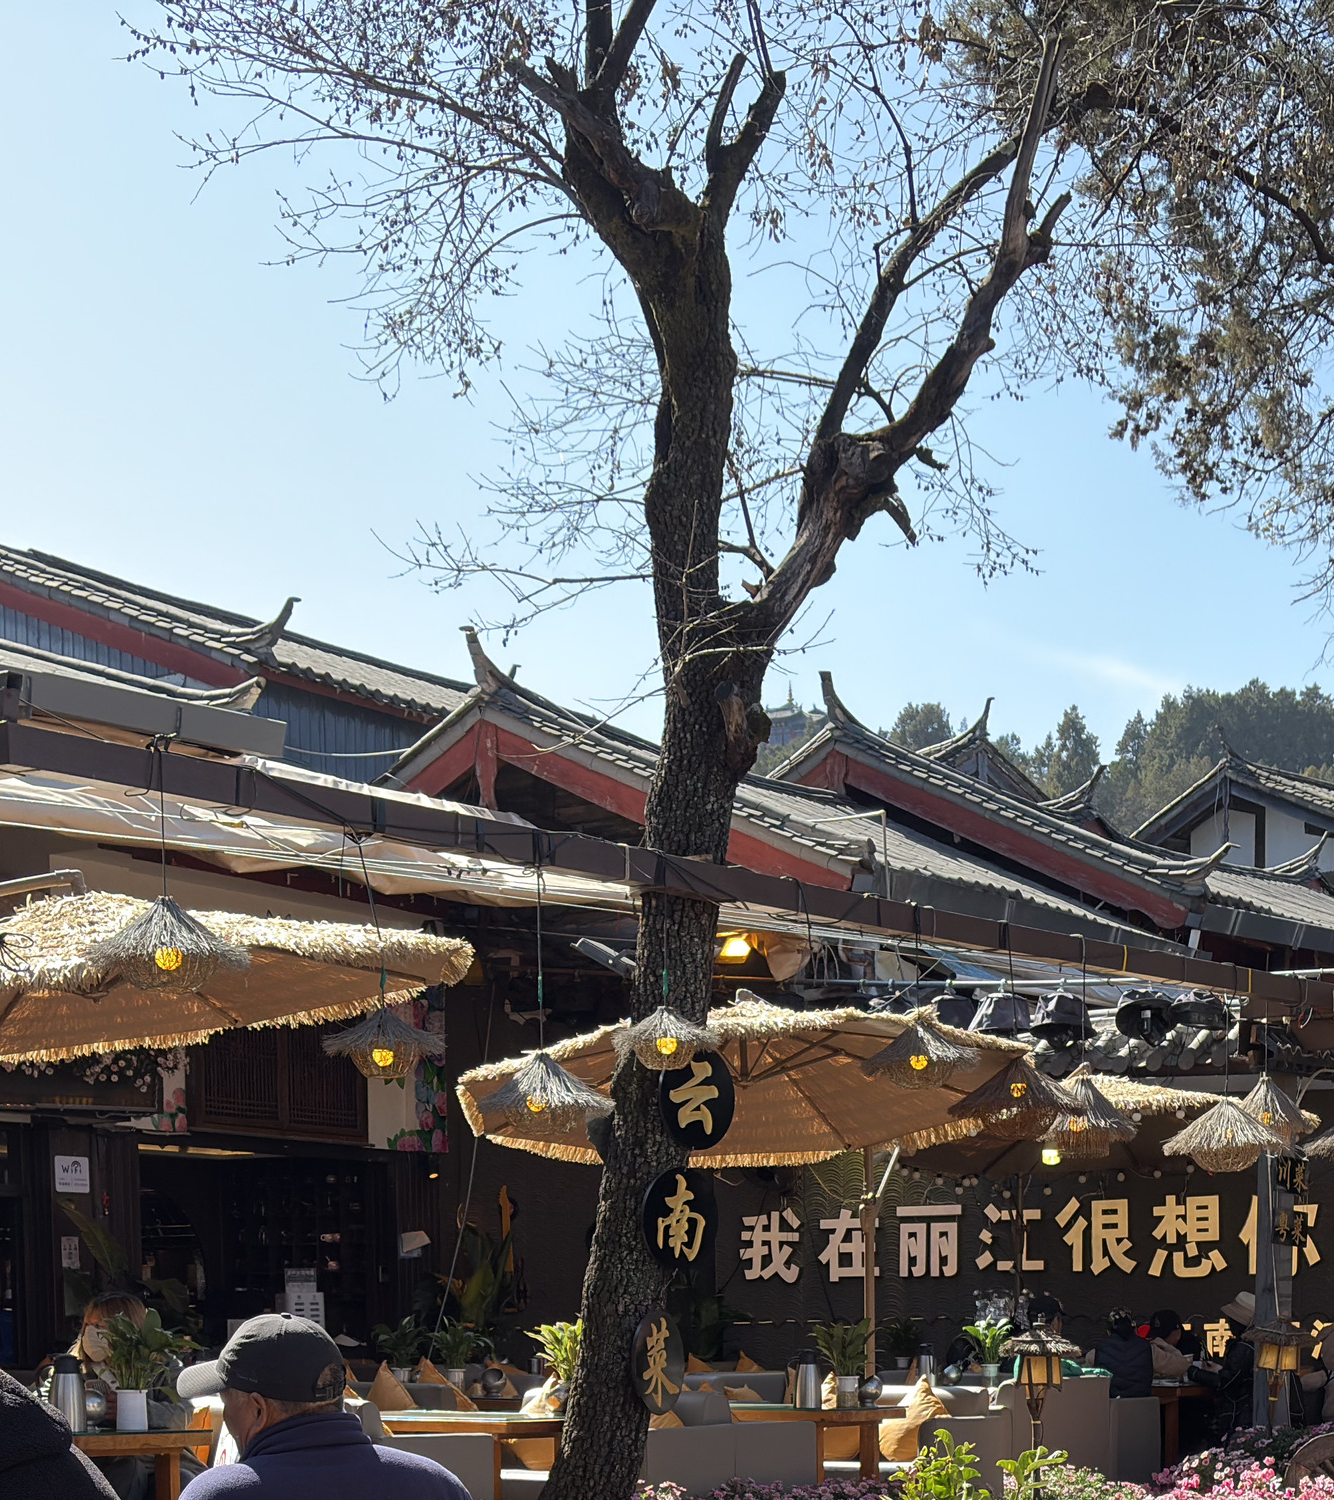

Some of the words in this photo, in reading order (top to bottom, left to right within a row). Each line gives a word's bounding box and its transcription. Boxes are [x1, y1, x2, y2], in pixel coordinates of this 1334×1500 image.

[669, 1060, 719, 1135] 云
[656, 1173, 707, 1262] 南
[1278, 1160, 1308, 1193] 川菜
[739, 1194, 1321, 1284] 我在丽江很想你
[1275, 1211, 1307, 1245] 粤菜
[642, 1316, 680, 1408] 菜
